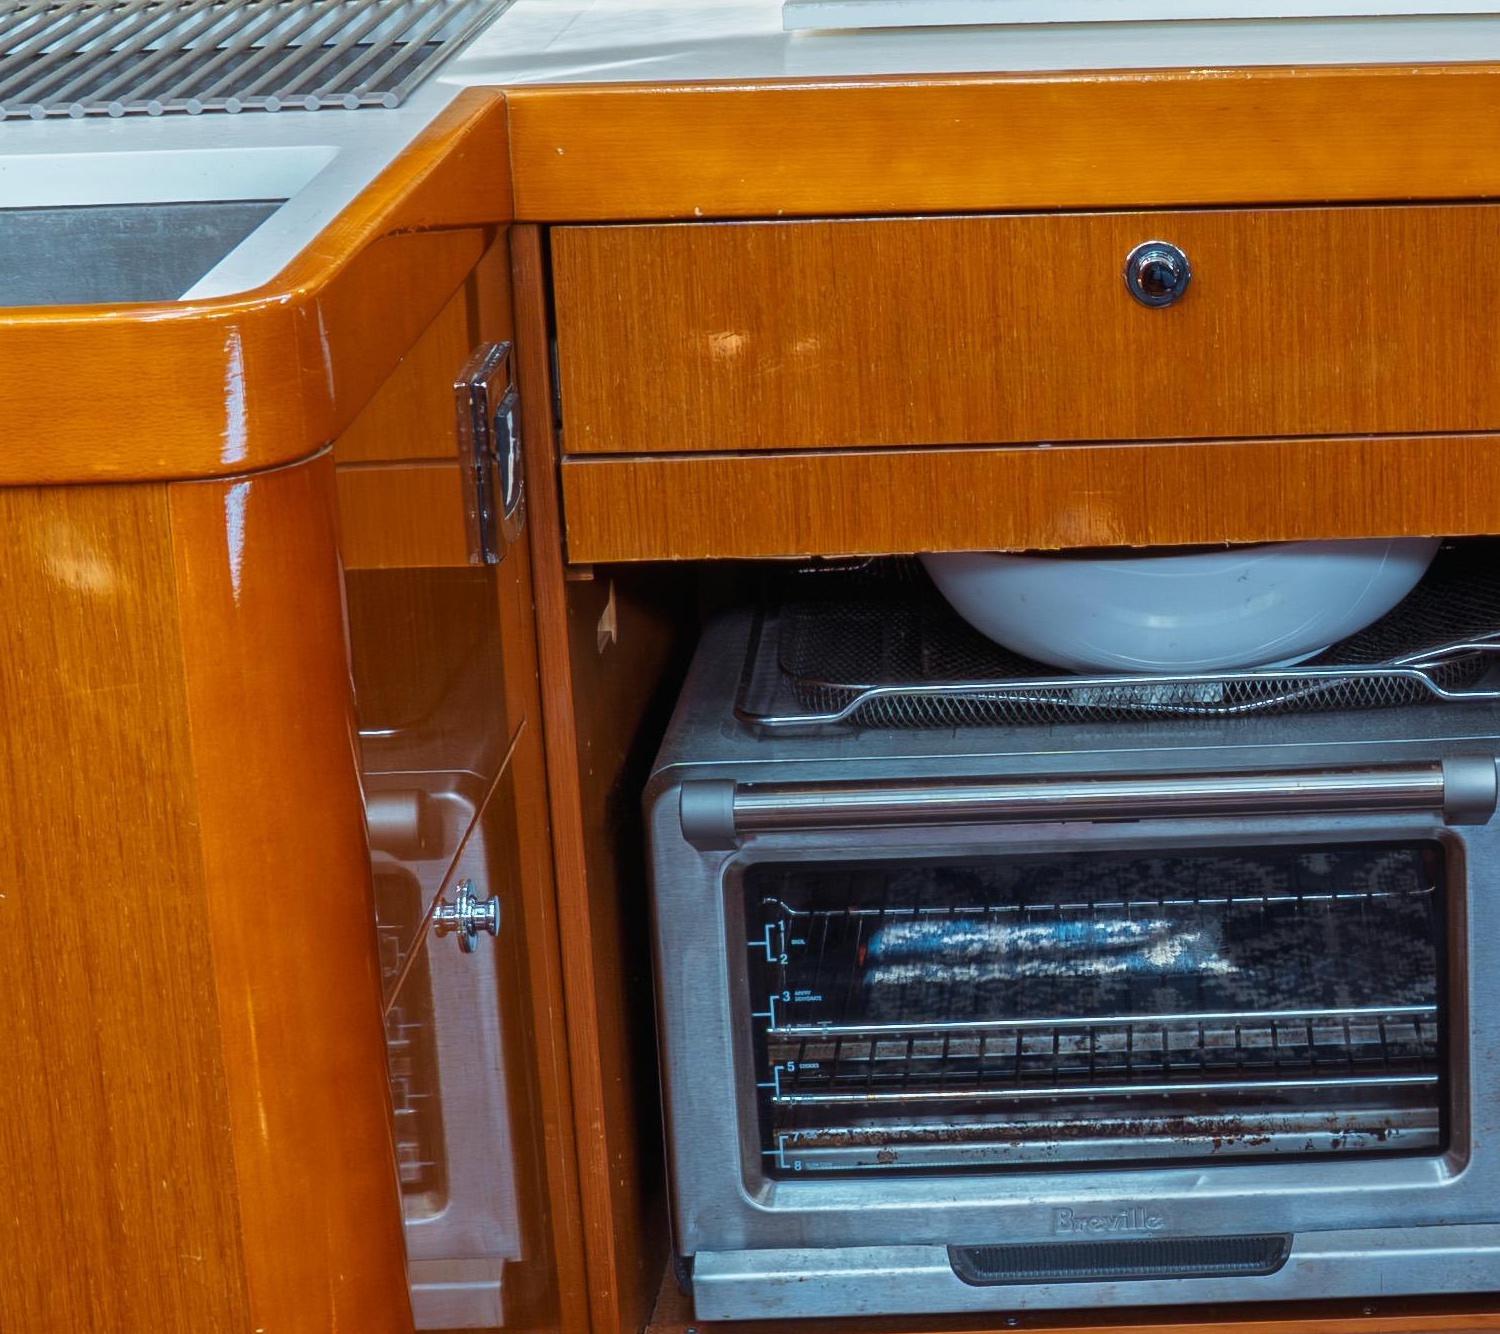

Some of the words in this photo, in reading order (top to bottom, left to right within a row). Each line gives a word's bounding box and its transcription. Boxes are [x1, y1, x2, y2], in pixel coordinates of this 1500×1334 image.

[780, 953, 788, 964] 2
[782, 990, 791, 1002] 3
[787, 1061, 795, 1072] 5
[794, 1160, 802, 1171] 8
[1051, 1207, 1164, 1234] Breville
